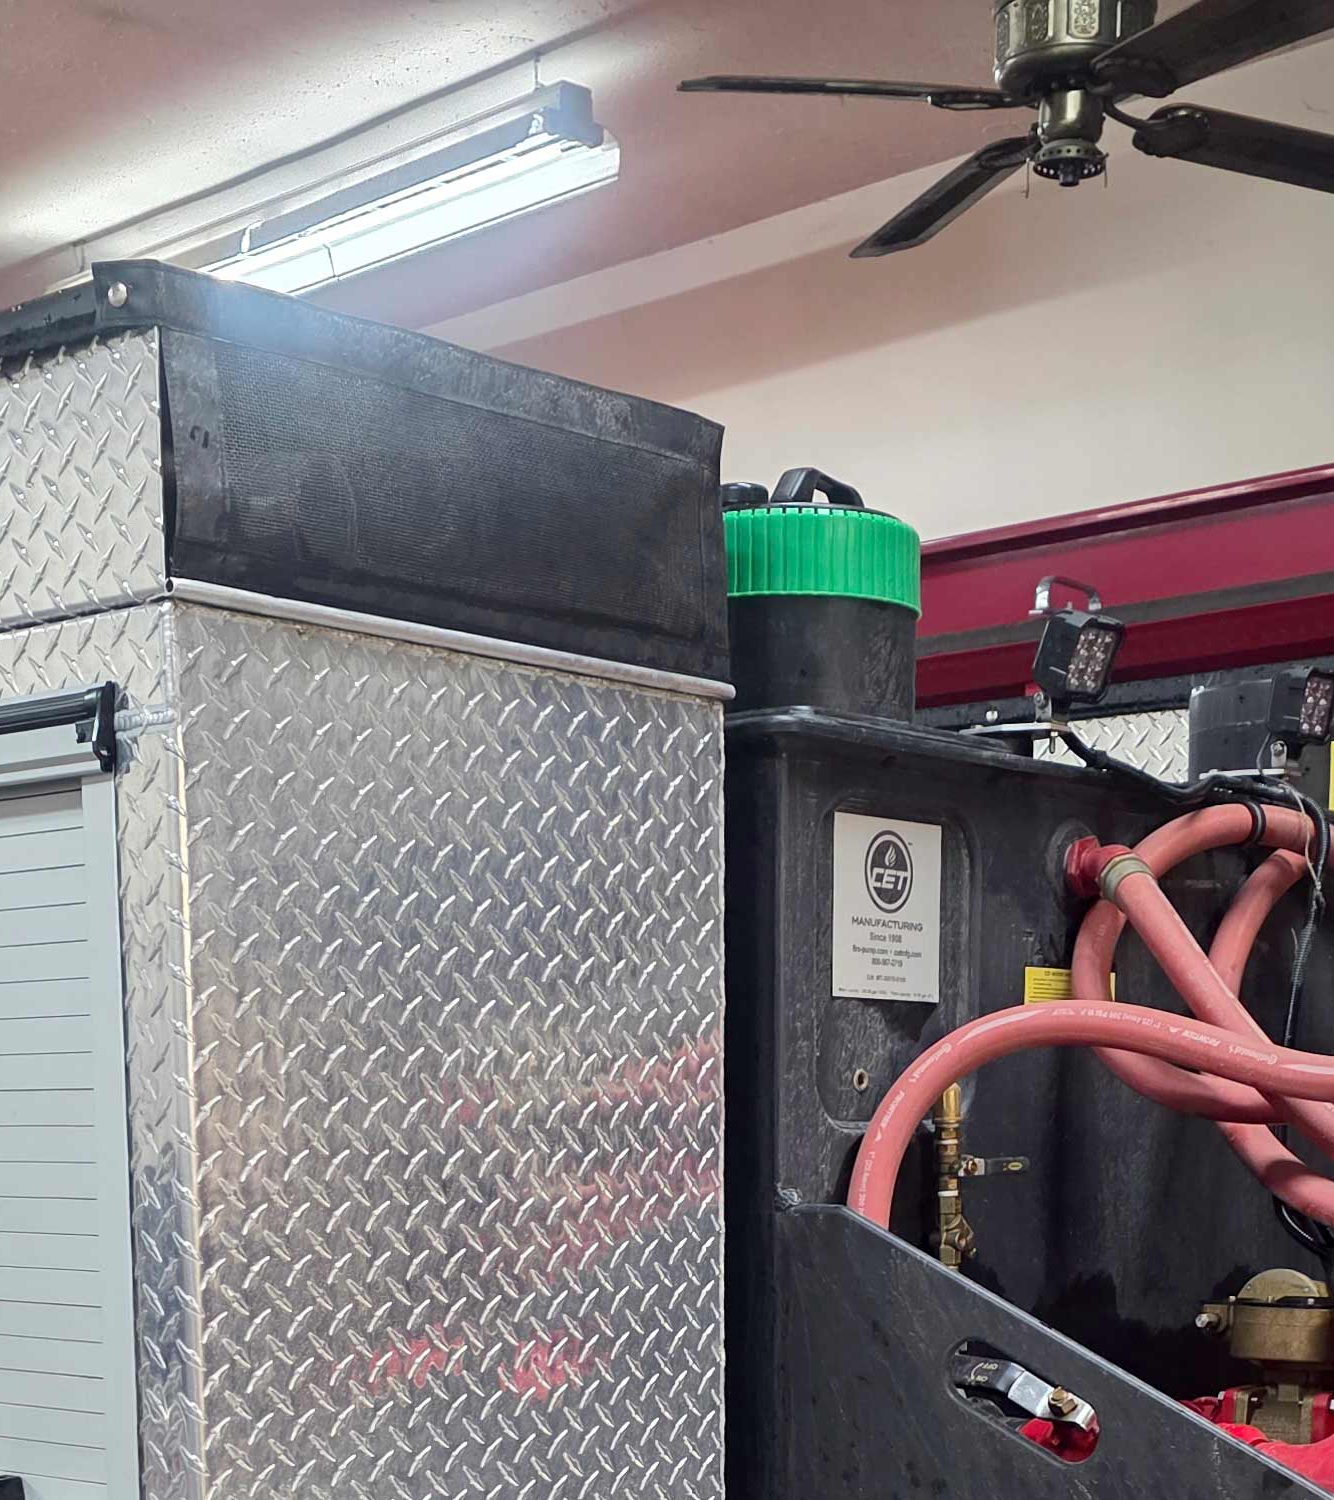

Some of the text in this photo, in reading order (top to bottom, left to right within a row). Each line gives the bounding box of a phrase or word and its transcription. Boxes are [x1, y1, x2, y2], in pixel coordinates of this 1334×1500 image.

[871, 867, 909, 891] CET
[851, 916, 923, 932] MANUFACTURING
[870, 932, 887, 942] Since
